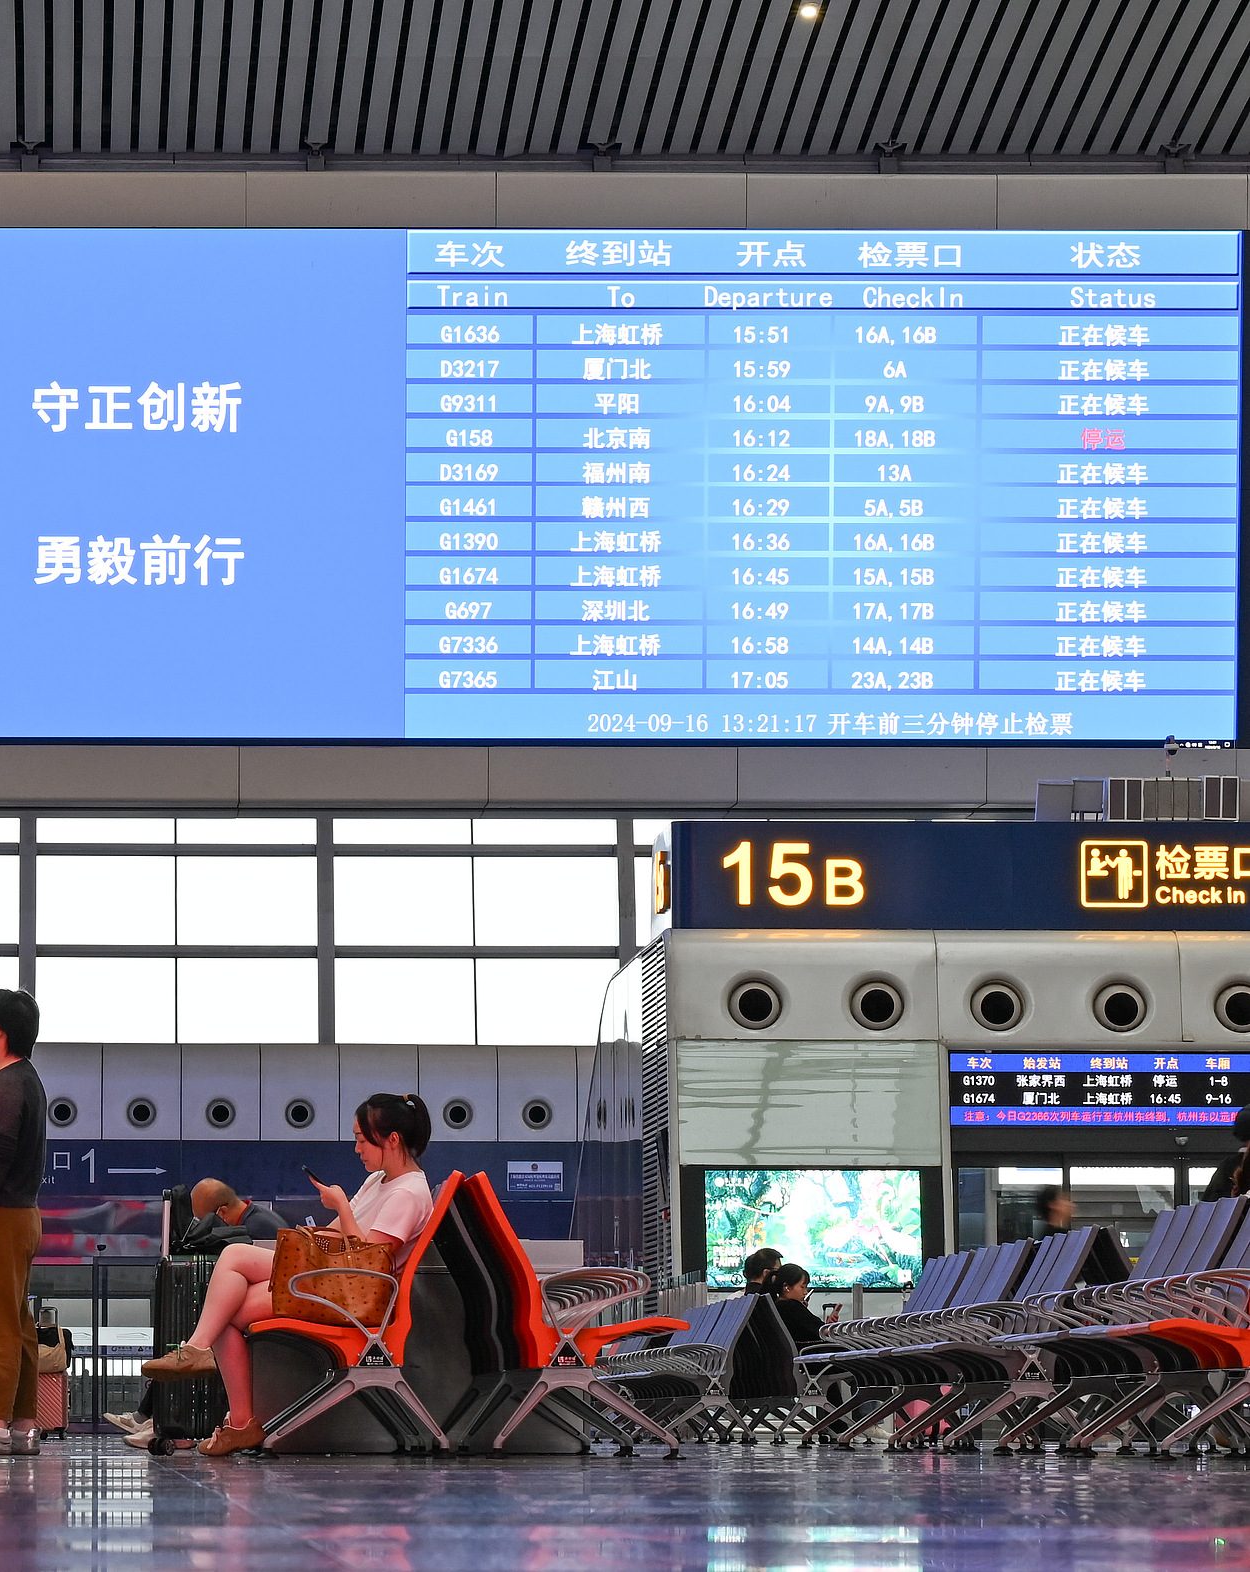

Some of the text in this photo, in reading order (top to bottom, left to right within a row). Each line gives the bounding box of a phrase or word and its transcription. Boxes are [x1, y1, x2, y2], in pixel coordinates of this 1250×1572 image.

[434, 239, 1141, 269] 车次 终到站 开点 检票口 状态
[436, 286, 508, 307] Train
[607, 286, 635, 308] To
[704, 286, 833, 311] Departure
[1070, 286, 1156, 309] Status
[440, 325, 500, 344] G1636
[571, 322, 664, 346] 上海虹桥
[733, 325, 788, 344] 15:51
[1058, 323, 1150, 347] 正在候车
[440, 357, 791, 381] D3217 厦门北 15:59
[31, 380, 242, 433] 守正创新
[440, 394, 496, 413] G9311
[594, 393, 639, 415] 平阳
[446, 426, 1126, 451] G158 北京南 16:12 停运
[440, 461, 912, 484] D3169 福州南 16:24 13A
[439, 498, 496, 516] G1461
[732, 498, 790, 517] 16:29
[439, 532, 499, 551] G1390
[570, 530, 662, 553] 上海虹桥
[33, 533, 245, 586] 勇毅前行
[439, 564, 790, 588] G1674 上海虹桥 16:45
[445, 601, 493, 620] G697
[581, 599, 650, 622] 深圳北
[731, 602, 789, 620] 16:49
[439, 633, 789, 657] G7336 上海虹桥 16:58
[438, 670, 498, 689] G7365
[592, 669, 637, 691] 江山
[587, 711, 1074, 736] 2024-09-16 13:21:17 开车前三分钟停止检票
[722, 841, 865, 906] 15B
[1155, 885, 1246, 905] Check in
[966, 1056, 1231, 1070] 车次 始发站 终到站 开点 车厢
[962, 1074, 1229, 1088] G1370 张家界西 上海虹桥 停运 1-8
[963, 1091, 1232, 1106] G1674 厦门北 上海虹桥 16:45 9-16
